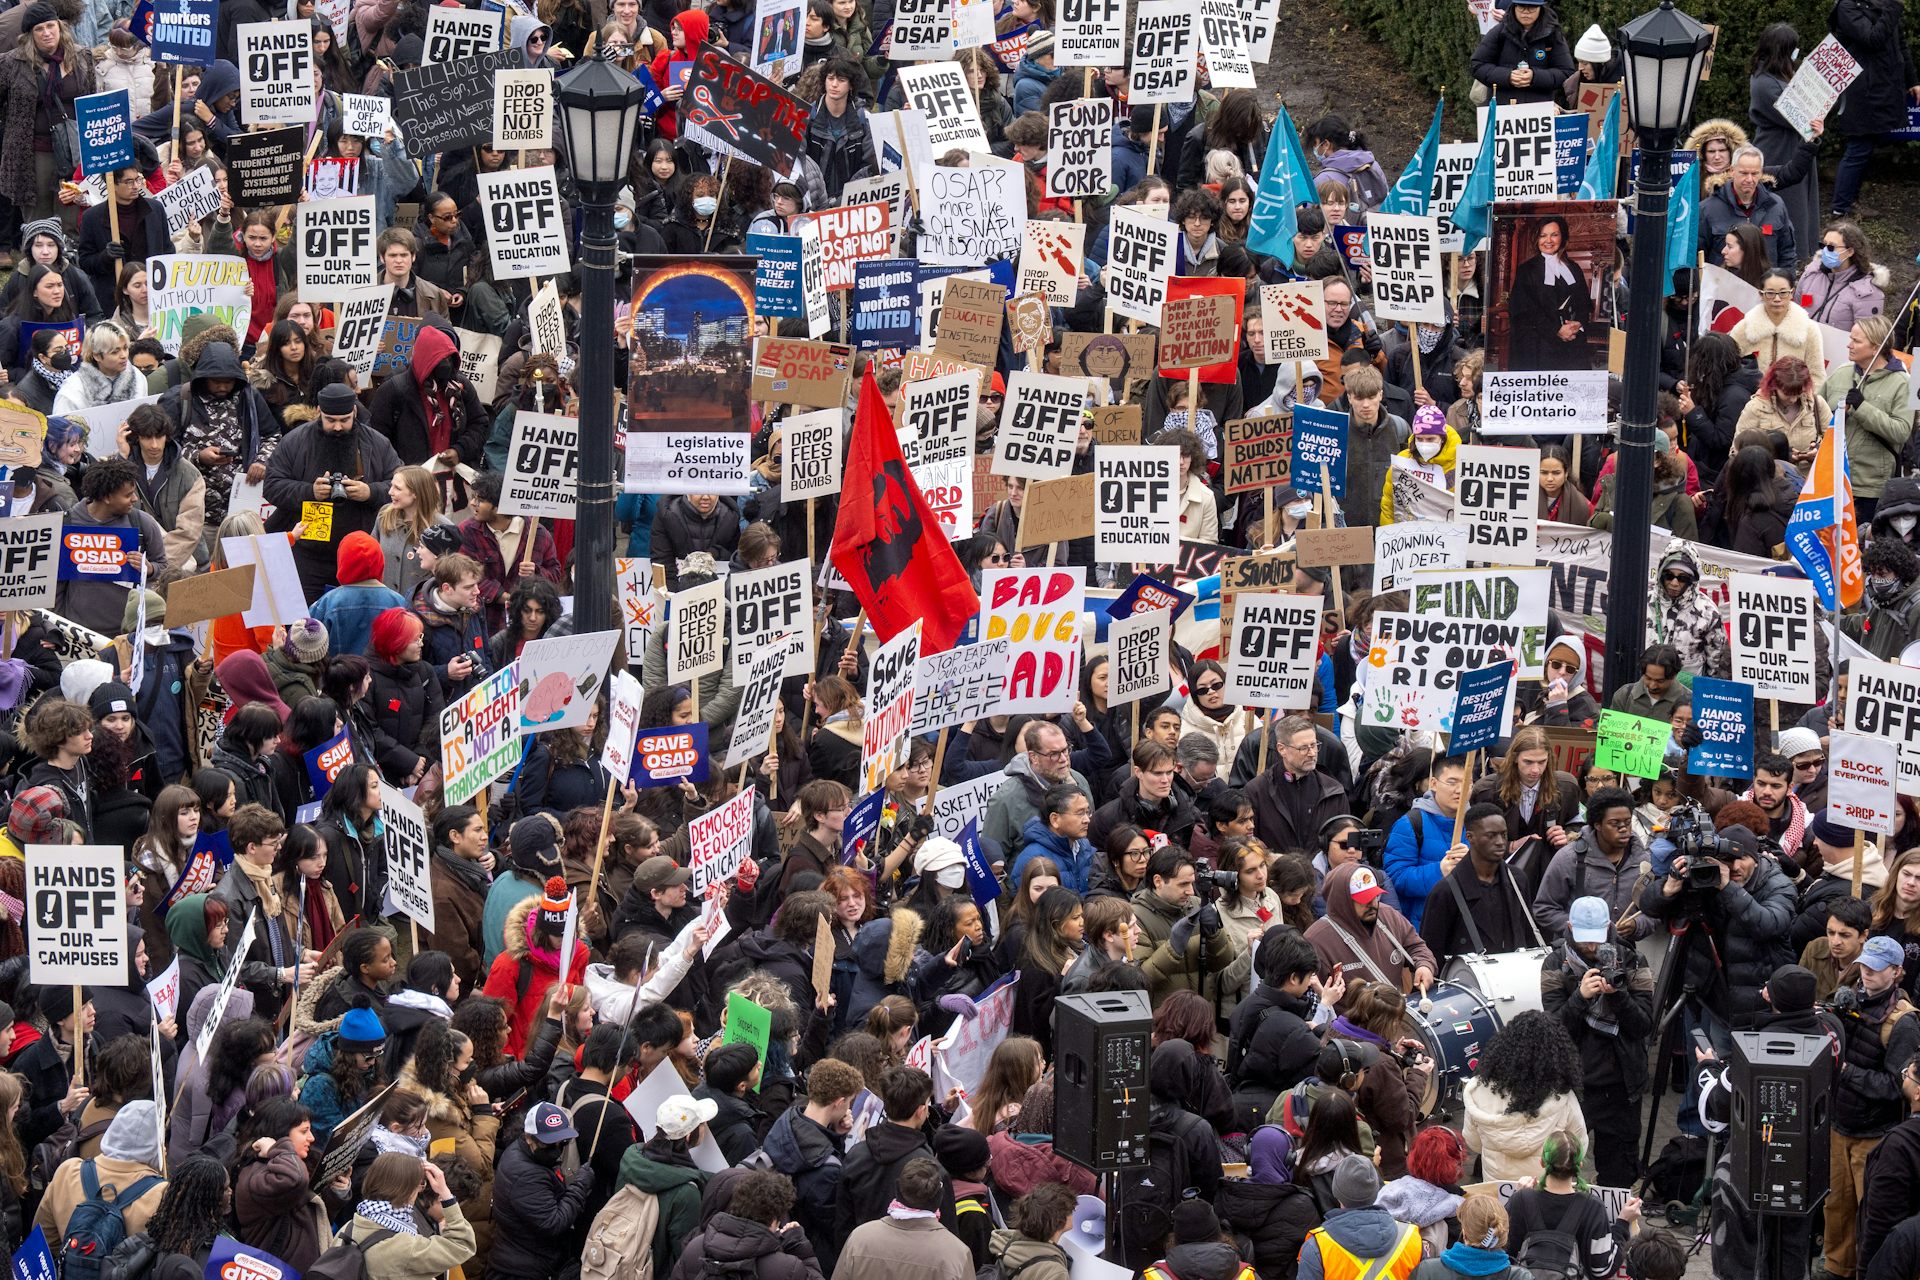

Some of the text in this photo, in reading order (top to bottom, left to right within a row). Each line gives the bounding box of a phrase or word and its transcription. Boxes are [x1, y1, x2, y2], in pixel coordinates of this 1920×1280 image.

[160, 13, 210, 25] workers
[913, 15, 935, 24] OUR
[1139, 14, 1191, 31] HANDS
[155, 24, 211, 47] UNITED
[1079, 25, 1103, 35] OUR
[247, 33, 308, 51] HANDS
[994, 32, 1028, 53] SAVE
[1062, 38, 1120, 49] EDUCATION
[249, 51, 308, 82] OFF
[1151, 58, 1173, 68] OUR
[267, 83, 293, 94] OUR
[1134, 70, 1188, 90] OSAP
[504, 84, 545, 98] DROP
[250, 96, 311, 108] EDUCATION
[349, 97, 384, 113] HANDS
[86, 115, 122, 129] HANDS
[358, 110, 375, 122] OFF
[939, 117, 962, 128] OUR
[1054, 102, 1110, 127] FUND
[352, 121, 383, 135] OSAP!
[502, 129, 543, 140] BOMBS
[1050, 128, 1110, 149] PEOPLE
[250, 144, 283, 158] RESPECT
[1062, 150, 1096, 166] NOT
[232, 152, 301, 169] STUDENTS' RIGHTS
[240, 163, 293, 178] TO DISMANTLE
[1508, 171, 1534, 181] OUR
[244, 174, 290, 188] SYSTEMS OF
[931, 170, 1007, 200] OSAP?
[161, 172, 207, 208] PROTECT
[242, 184, 292, 197] OPPRESSION!
[488, 180, 552, 200] HANDS
[178, 191, 203, 209] OUR
[939, 199, 1005, 217] more like
[169, 188, 222, 234] EDUCATION
[305, 209, 370, 227] HANDS
[491, 198, 554, 233] OFF
[820, 206, 883, 240] FUND
[931, 215, 1015, 238] OH SNAP!
[514, 233, 539, 245] OUR
[1371, 226, 1429, 242] HANDS
[305, 228, 370, 258] OFF
[923, 234, 943, 253] I'M
[497, 245, 560, 261] EDUCATION
[1372, 241, 1430, 270] OFF
[324, 260, 351, 271] OUR
[859, 259, 914, 269] student solidarity
[171, 261, 248, 288] FUTURE
[306, 273, 370, 285] EDUCATION
[765, 269, 784, 279] THE
[858, 271, 912, 291] students
[1125, 268, 1147, 283] OUR
[1391, 270, 1415, 282] OUR
[756, 278, 795, 289] FREEZE!
[1023, 279, 1056, 293] FEES
[153, 288, 215, 311] WITHOUT
[948, 284, 1006, 304] AGITATE
[1377, 282, 1434, 303] OSAP
[860, 296, 910, 313] workers
[1167, 299, 1206, 312] WHY IS
[856, 310, 910, 331] UNITED
[945, 307, 996, 327] EDUCATE
[1168, 308, 1216, 322] DROP-OUT
[1167, 317, 1220, 334] SPEAKING
[940, 329, 998, 345] INSTIGATE
[1175, 328, 1216, 341] ON OUR
[1161, 339, 1229, 362] EDUCATION
[1271, 337, 1306, 350] FEES
[462, 350, 488, 362] FIGHT
[461, 360, 477, 371] THE
[783, 362, 833, 381] OSAP
[1490, 375, 1568, 388] Assemblée
[1490, 389, 1563, 404] législative
[1104, 411, 1123, 425] OF
[1489, 405, 1577, 418] de l'Ontario
[667, 436, 744, 451] Legislative
[1027, 431, 1055, 444] OUR
[1301, 432, 1338, 447] HANDS
[674, 452, 744, 468] Assembly
[1005, 442, 1071, 467] OSAP
[1235, 441, 1282, 464] BUILDS
[668, 467, 748, 480] of Ontario.
[1100, 461, 1169, 478] HANDS
[1461, 462, 1530, 480] HANDS
[532, 478, 559, 489] OUR
[790, 475, 832, 491] BOMBS
[1101, 481, 1168, 513] OFF
[1460, 479, 1529, 510] OFF
[1120, 516, 1148, 528] OUR
[1480, 510, 1507, 522] OUR
[69, 536, 117, 548] SAVE
[1101, 532, 1170, 544] EDUCATION
[1382, 534, 1445, 559] DROWNING
[1552, 537, 1590, 555] YOUR
[74, 550, 123, 563] OSAP
[1391, 553, 1450, 573] IN DEBT
[1235, 559, 1295, 588] STUDENTS
[735, 572, 801, 601] HANDS
[992, 572, 1075, 610] BAD
[1416, 577, 1519, 620] FUND
[1738, 592, 1807, 615] HANDS
[1244, 607, 1315, 625] HANDS
[986, 611, 1079, 644] DOUG,
[1378, 617, 1520, 647] EDUCATION
[1739, 613, 1807, 651] OFF
[1240, 626, 1314, 659] OFF
[924, 640, 1008, 678] STOP EATING
[1398, 645, 1430, 665] IS
[1759, 652, 1787, 666] OUR
[873, 637, 917, 694] Save
[938, 667, 957, 680] OUR
[1258, 661, 1287, 674] OUR
[1237, 676, 1307, 689] EDUCATION
[1742, 667, 1809, 684] EDUCATION
[442, 662, 520, 737] EDUCATION
[1461, 686, 1505, 706] RESTORE
[1714, 694, 1742, 702] COALITION
[1473, 700, 1491, 713] THE
[1701, 708, 1742, 722] HANDS
[465, 687, 519, 745] A RIGHT
[1460, 706, 1498, 725] FREEZE!
[1697, 719, 1746, 734] OFF OUR
[643, 735, 689, 752] SAVE
[443, 739, 466, 782] IS
[647, 751, 695, 768] OSAP
[1611, 749, 1651, 773] FUN
[1841, 759, 1883, 776] BLOCK
[445, 737, 522, 806] TRANSACTION
[1834, 770, 1889, 787] EVERYTHING!
[691, 793, 754, 845] DEMOCRACY
[692, 817, 752, 865] REQUIRES
[34, 866, 115, 887] HANDS
[35, 890, 116, 929] OFF
[60, 933, 94, 947] OUR
[38, 951, 118, 966] CAMPUSES
